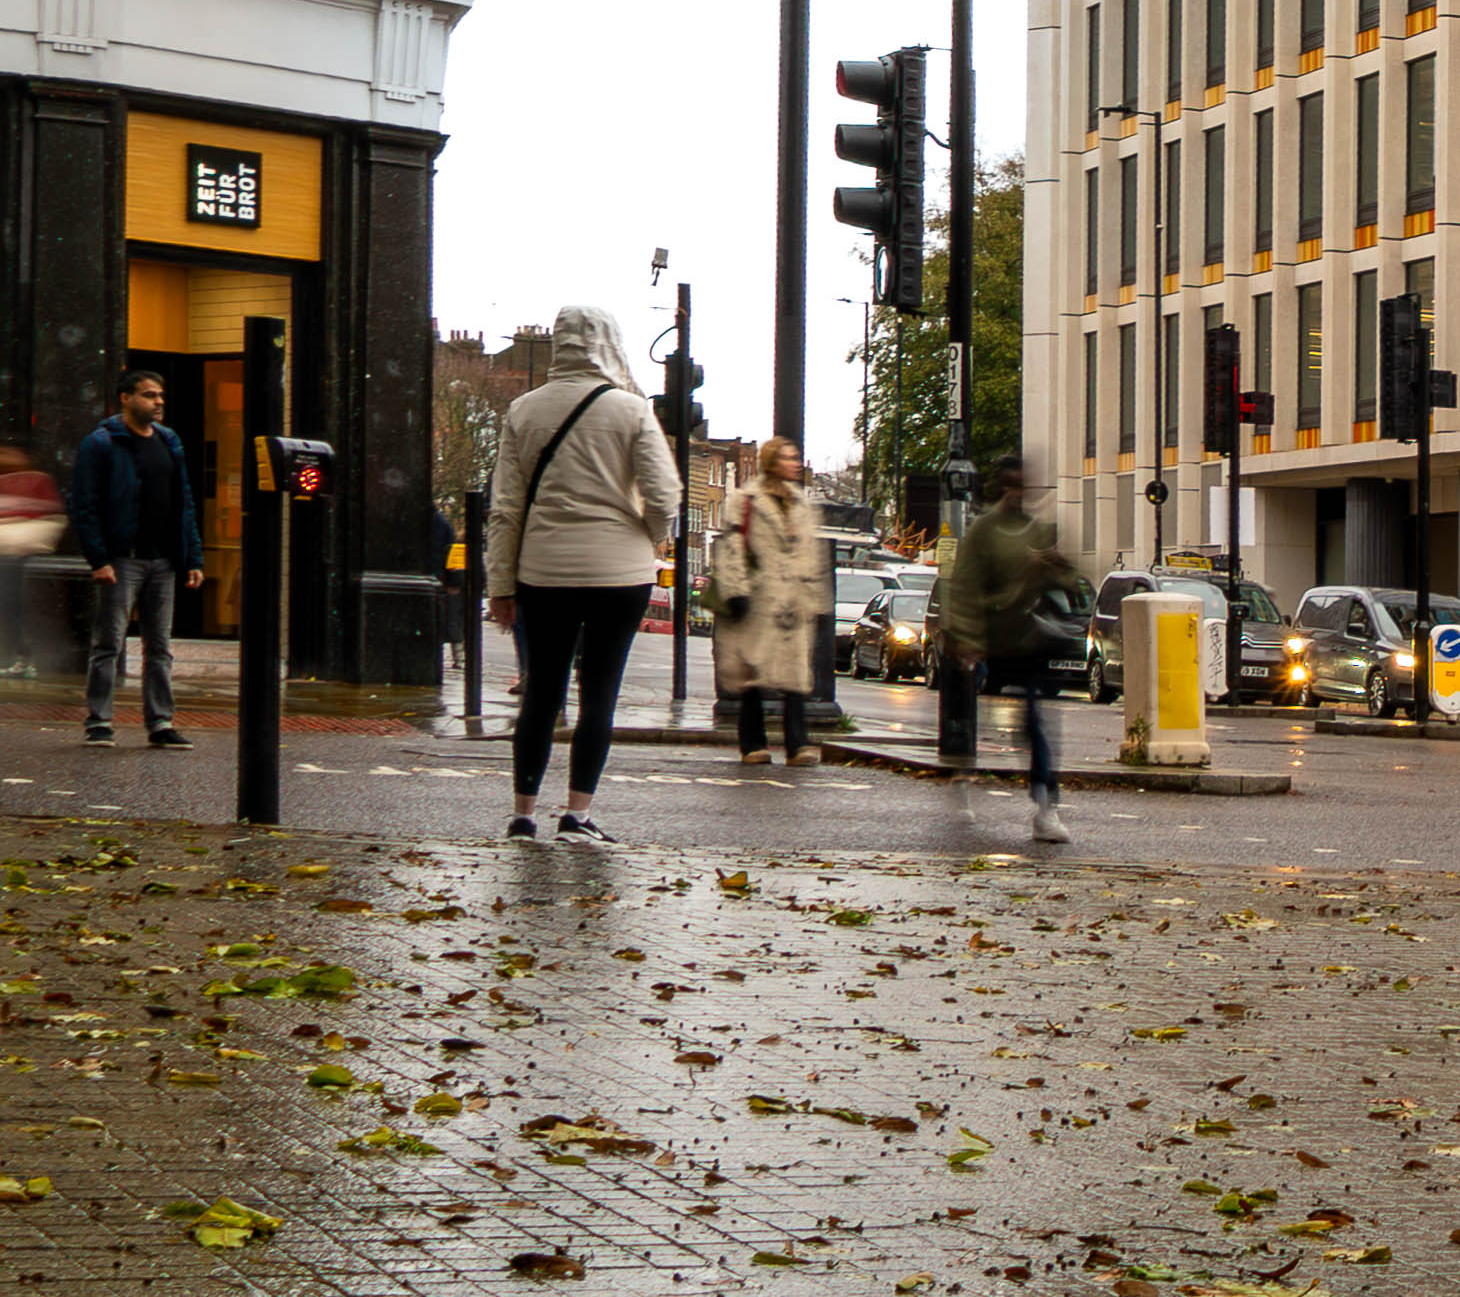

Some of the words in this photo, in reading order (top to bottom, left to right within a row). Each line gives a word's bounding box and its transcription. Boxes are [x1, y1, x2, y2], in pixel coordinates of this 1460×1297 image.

[197, 162, 217, 216] ZEIT
[215, 173, 237, 218] FÜR
[238, 162, 257, 220] BROT
